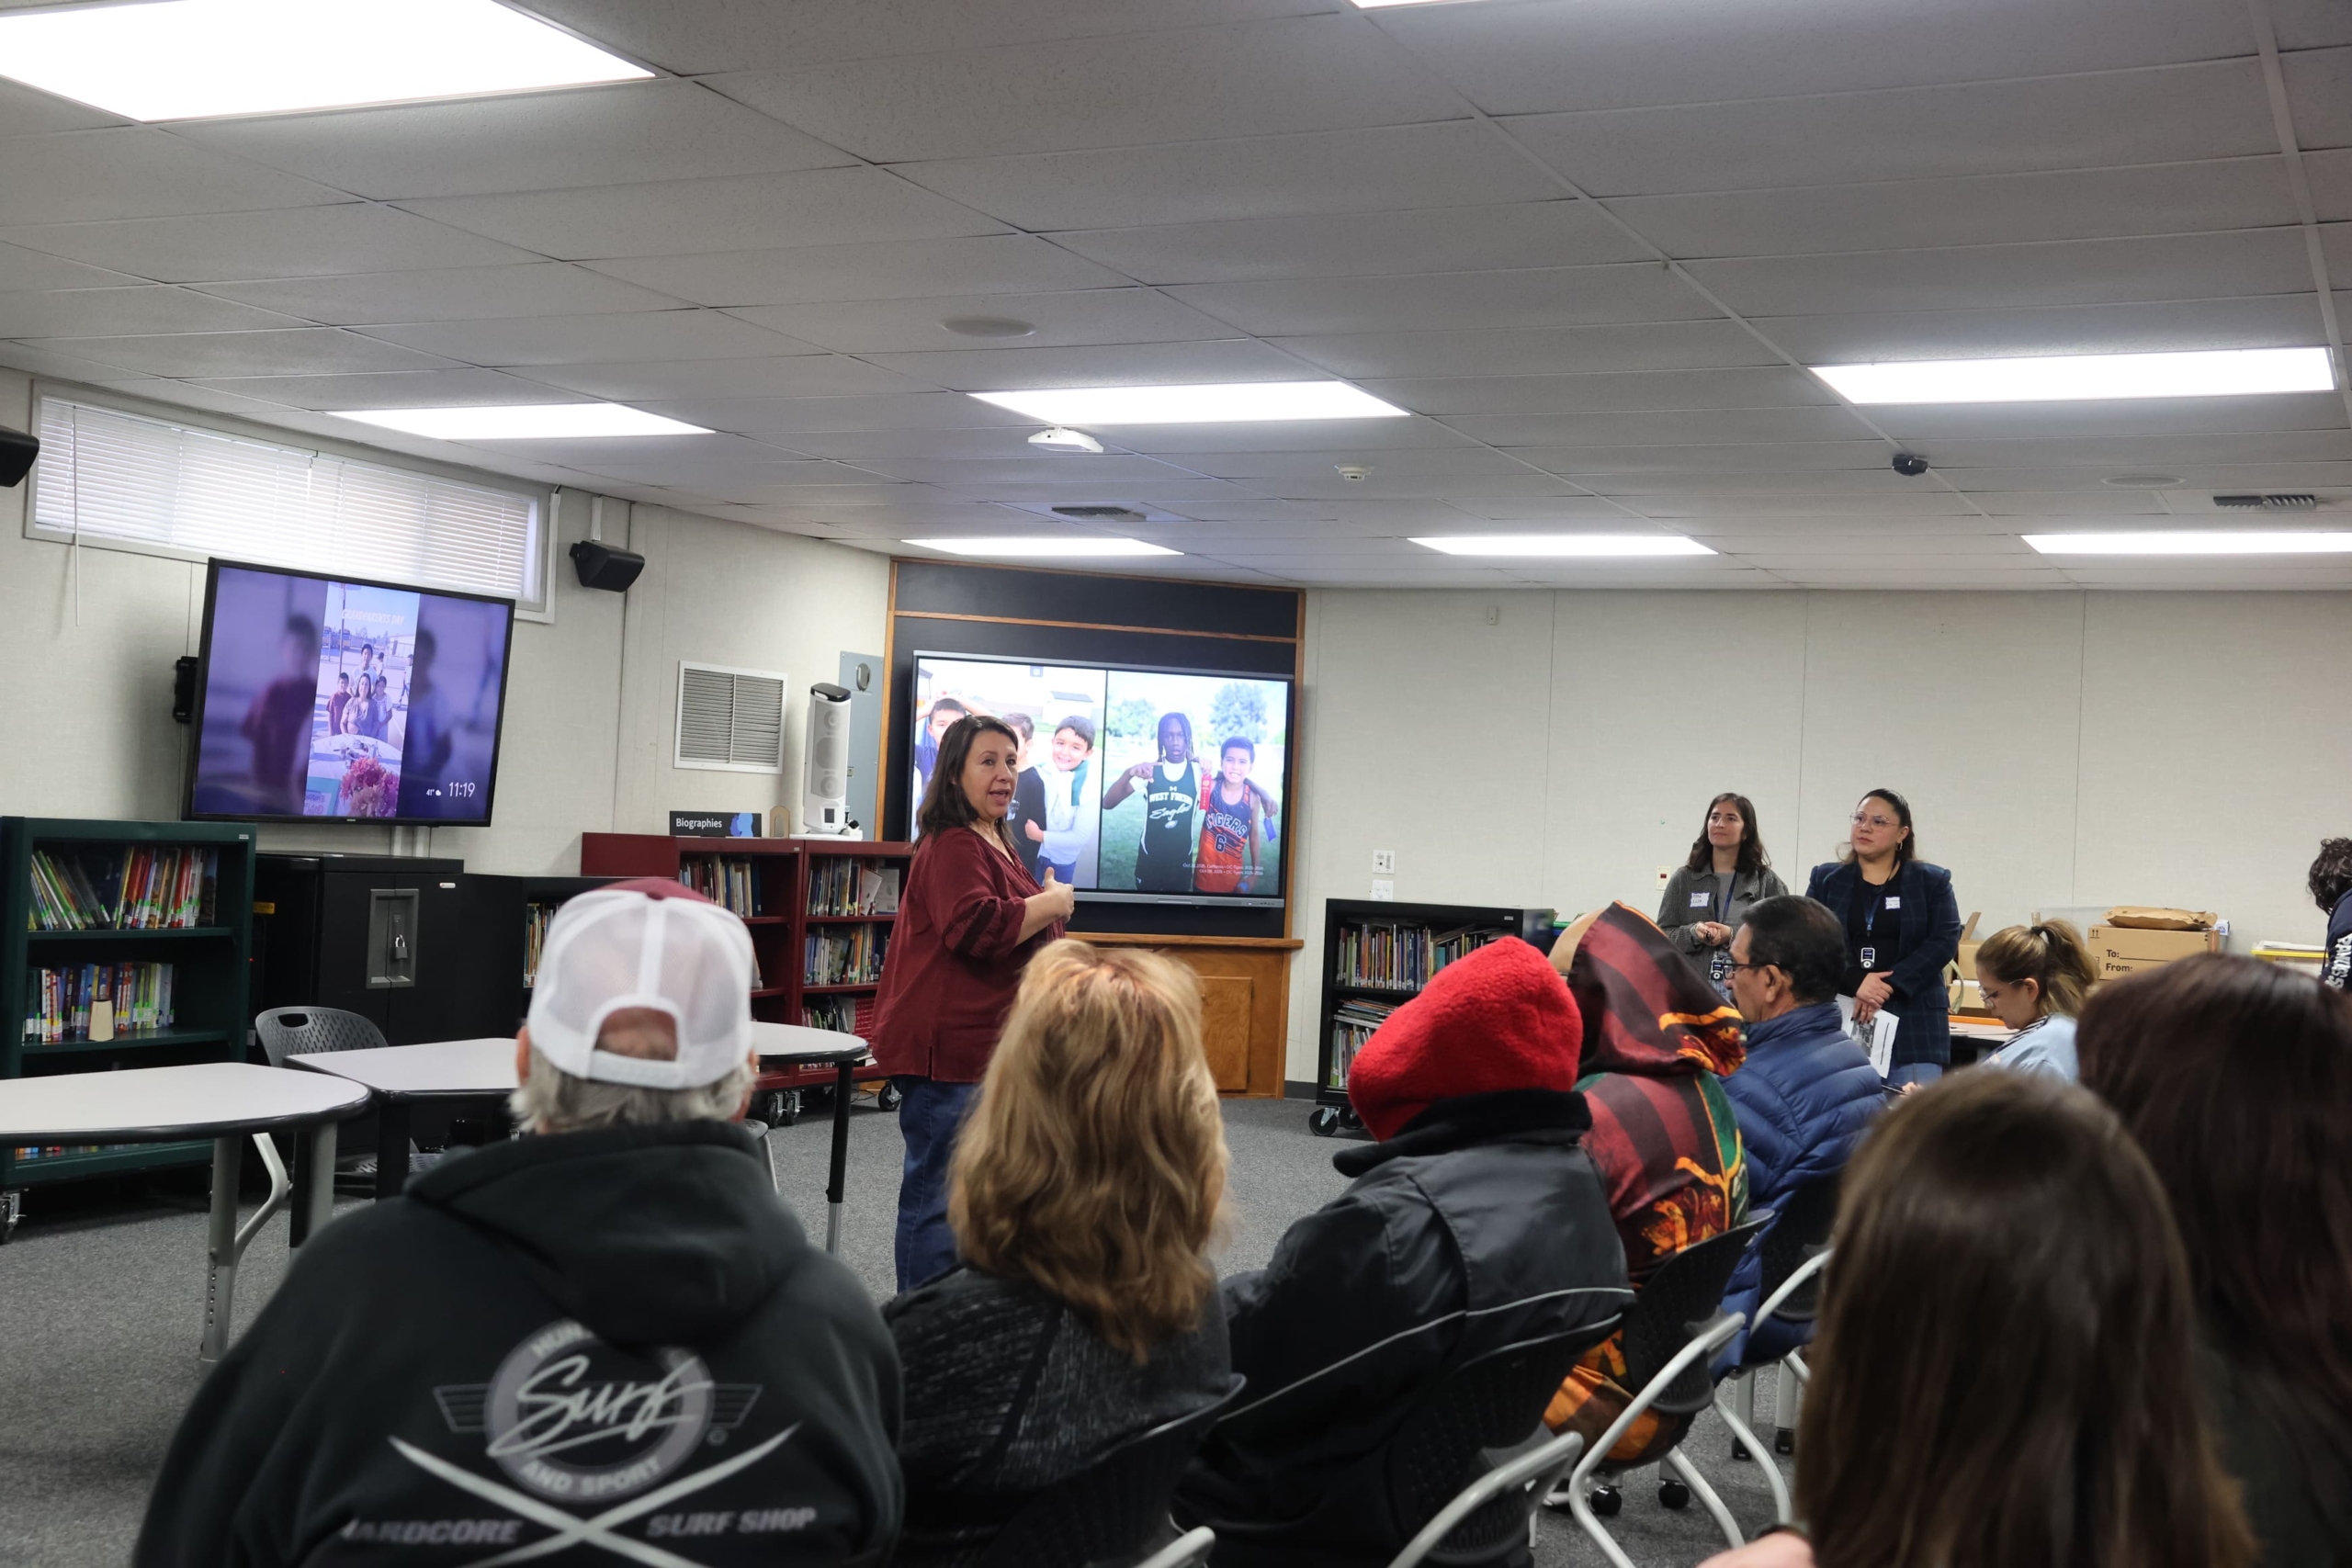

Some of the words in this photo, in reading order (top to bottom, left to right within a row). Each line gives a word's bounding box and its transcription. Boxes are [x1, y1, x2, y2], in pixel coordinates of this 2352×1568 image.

[448, 781, 476, 797] 11:19
[1149, 792, 1170, 804] WEST
[675, 818, 722, 829] Biographies
[1205, 812, 1248, 838] TIGERS
[1215, 834, 1227, 852] 6
[2106, 949, 2120, 958] To:
[2105, 963, 2133, 973] From:
[486, 1353, 715, 1458] Surf
[520, 1459, 573, 1495] AND
[580, 1455, 661, 1497] SPORT
[647, 1511, 735, 1538] SURF
[738, 1506, 818, 1534] SHOP
